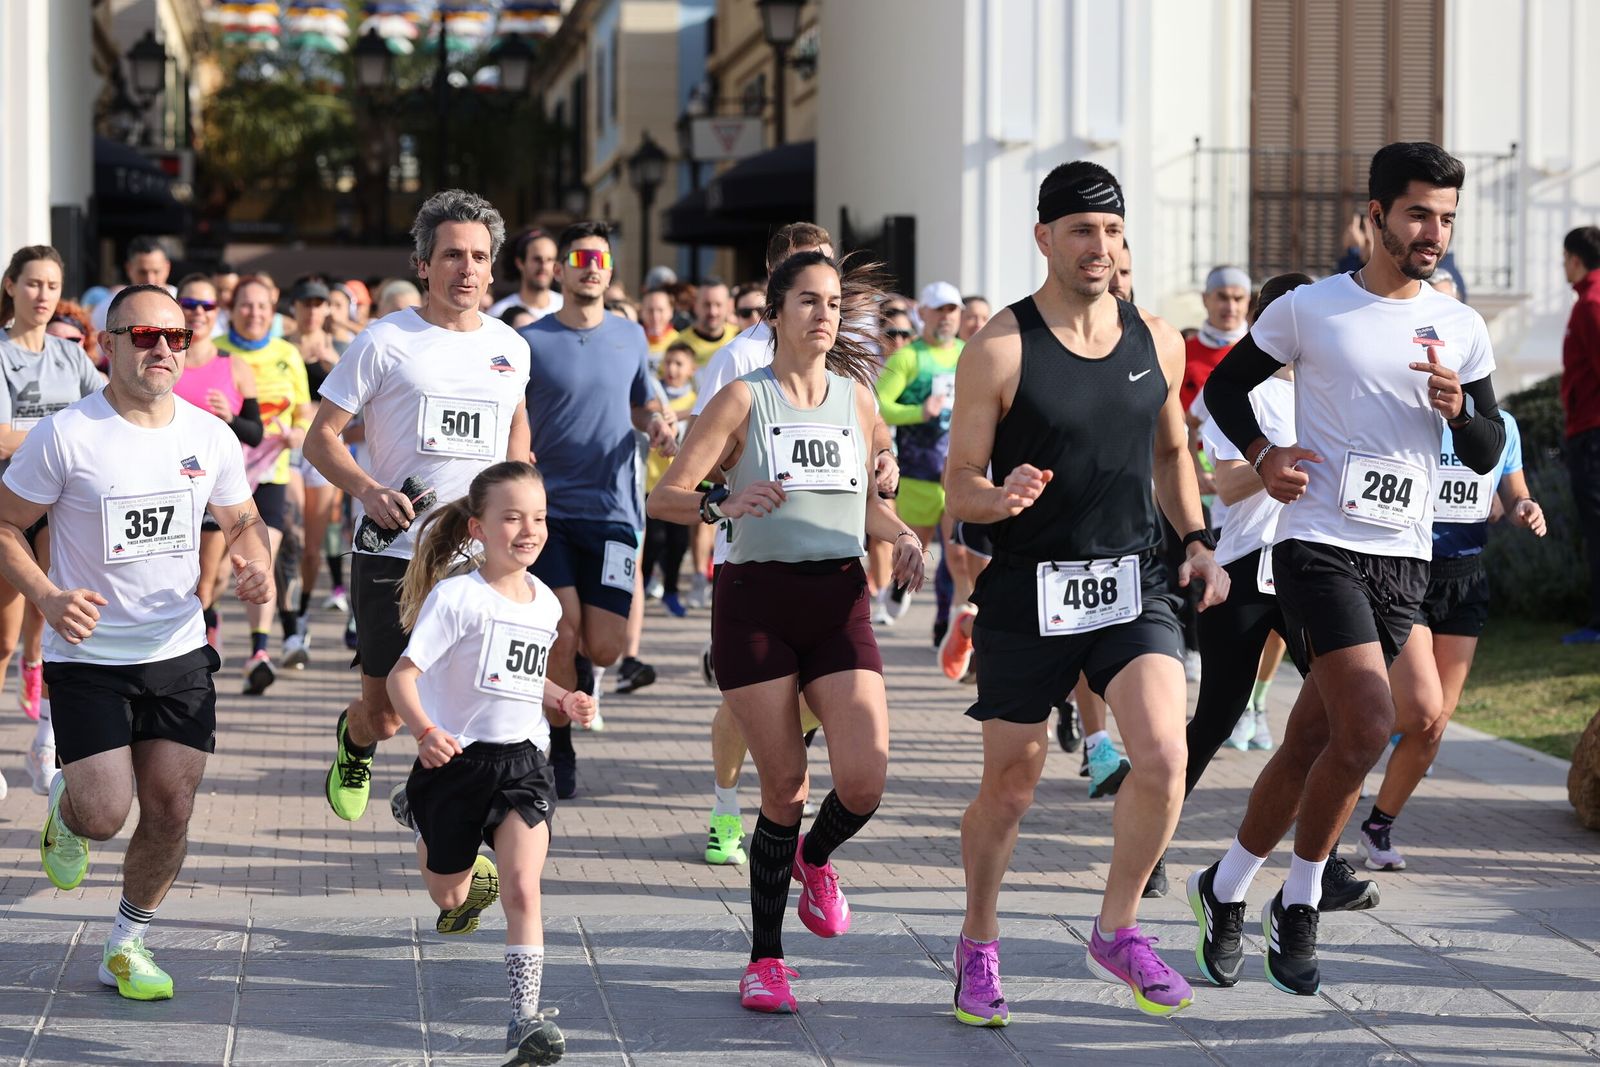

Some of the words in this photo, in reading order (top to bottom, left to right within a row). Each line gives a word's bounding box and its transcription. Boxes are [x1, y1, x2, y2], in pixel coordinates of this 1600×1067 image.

[441, 410, 480, 438] 501
[791, 439, 842, 468] 408
[1440, 453, 1463, 466] RE
[1361, 470, 1413, 508] 284
[1439, 480, 1478, 504] 494
[125, 506, 174, 539] 357
[1063, 577, 1118, 609] 488
[506, 639, 546, 677] 503
